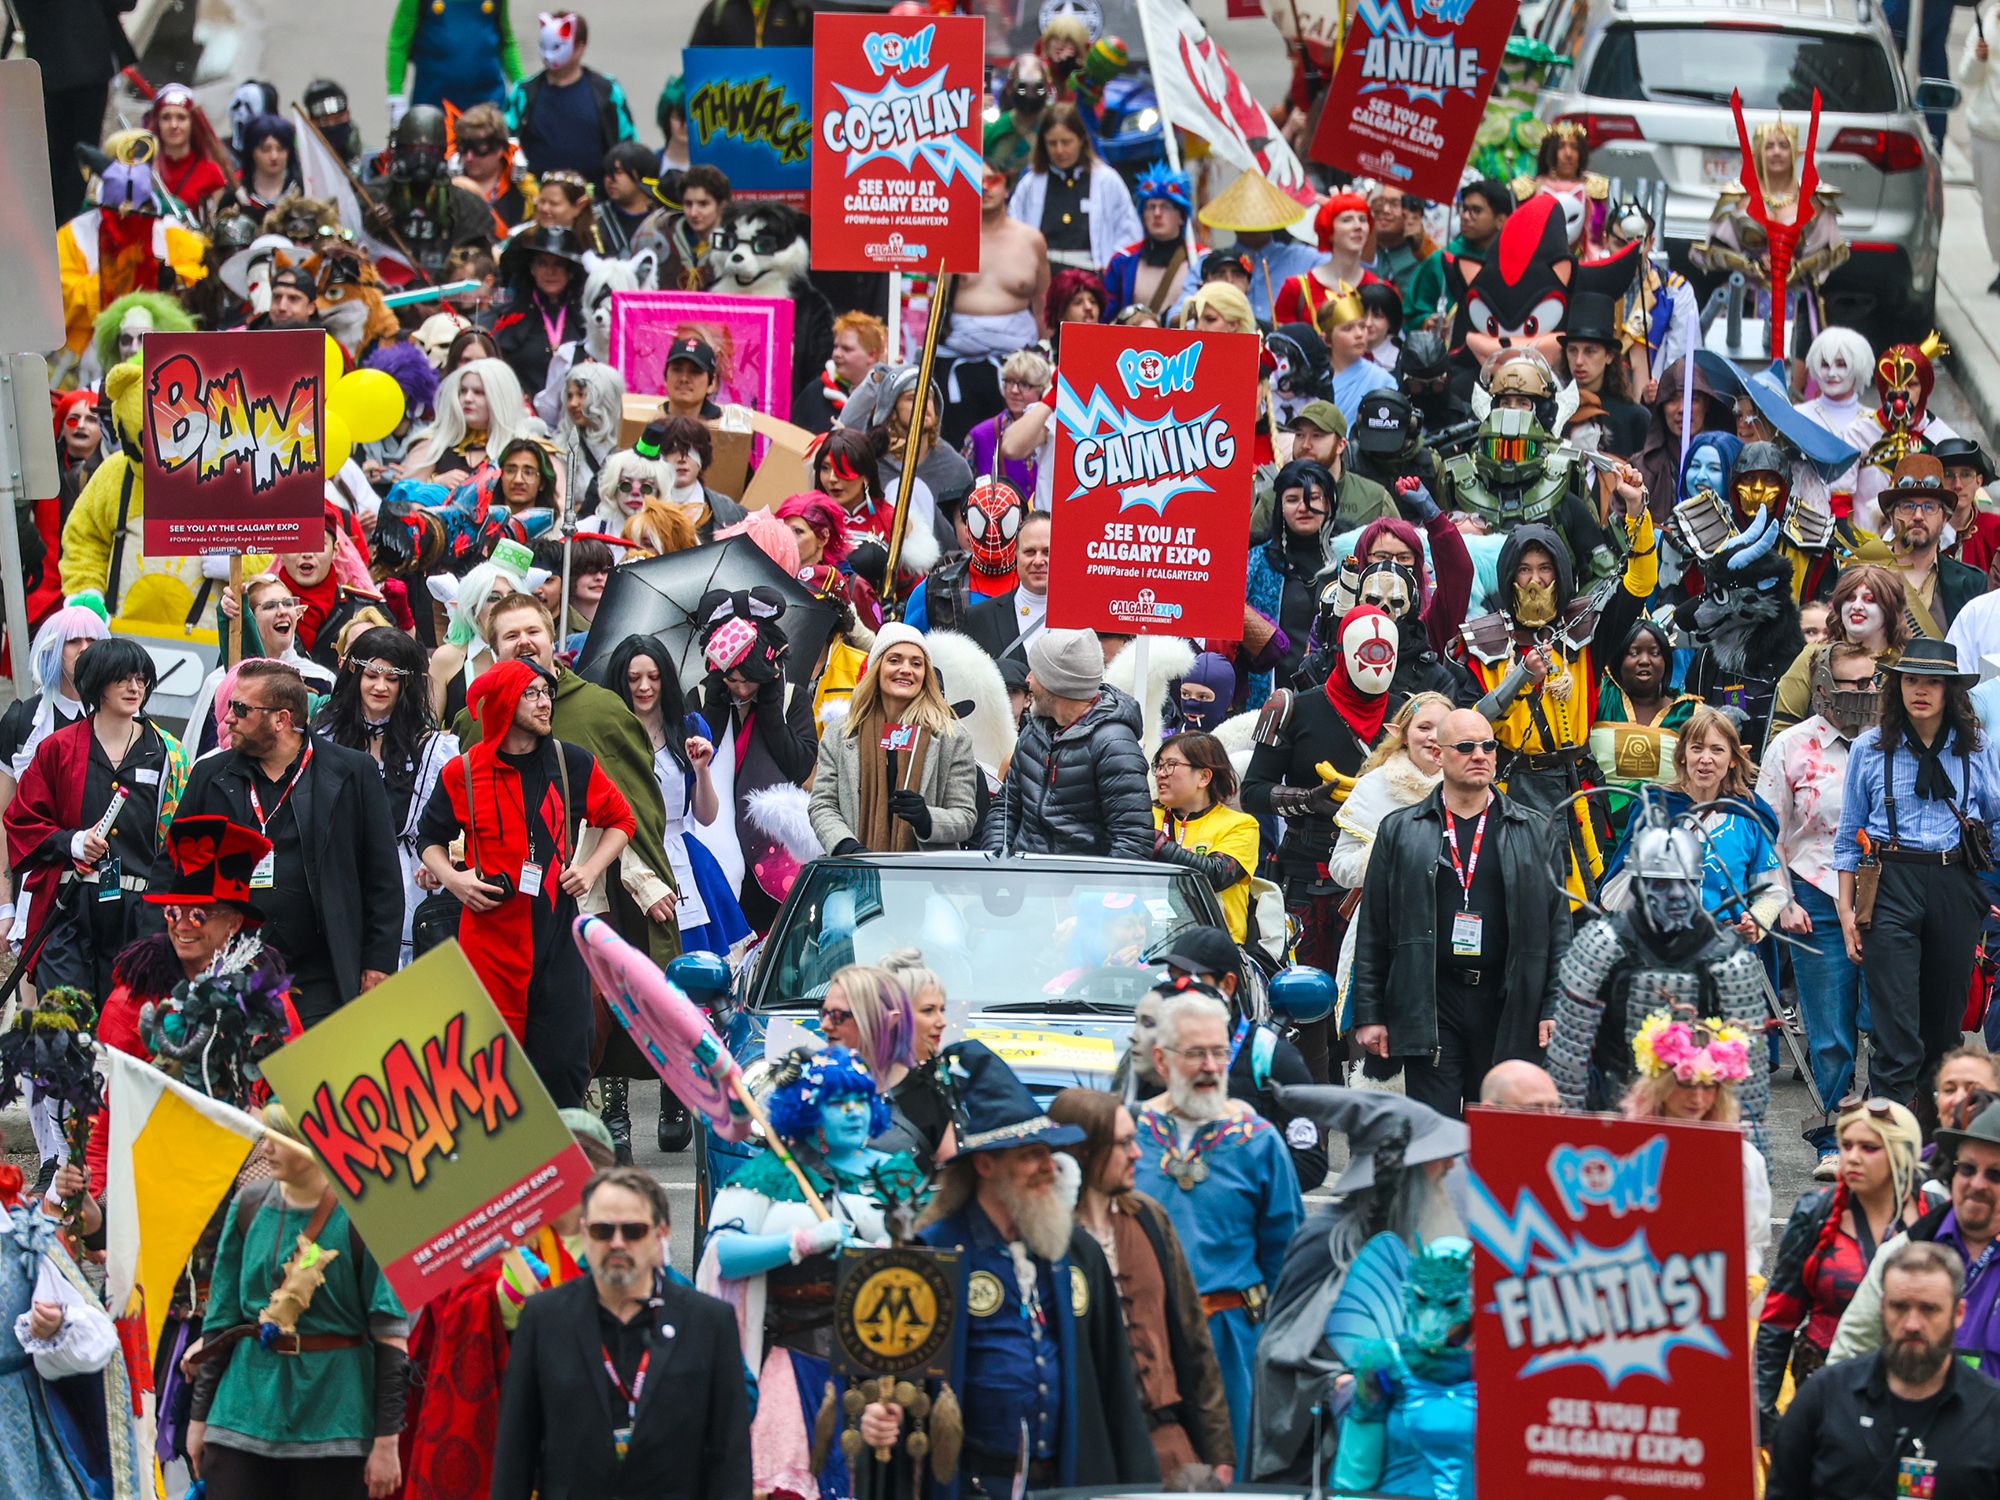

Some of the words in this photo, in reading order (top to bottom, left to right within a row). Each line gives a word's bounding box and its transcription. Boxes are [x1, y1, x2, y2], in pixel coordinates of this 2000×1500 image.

[863, 23, 936, 76] POW!
[1361, 37, 1478, 88] ANIME
[690, 76, 812, 164] THWACK
[822, 87, 970, 153] COSPLAY
[1352, 106, 1409, 137] CALGARY
[1410, 127, 1444, 149] EXPO
[1368, 97, 1392, 117] SEE
[1394, 104, 1420, 126] YOU
[1420, 116, 1438, 132] AT
[844, 195, 908, 212] CALGARY
[911, 197, 950, 213] EXPO
[858, 179, 883, 195] SEE
[886, 180, 915, 196] YOU
[918, 181, 936, 196] AT
[844, 214, 890, 225] #POWParade
[895, 216, 948, 226] #CALGARYEXPO
[1115, 340, 1203, 399] POW!
[147, 353, 320, 494] BAM
[1368, 417, 1399, 427] BEAR
[1072, 418, 1236, 489] GAMING
[169, 525, 184, 533] SEE
[187, 525, 205, 533] YOU
[219, 524, 235, 532] THE
[277, 523, 299, 531] EXPO
[1104, 523, 1133, 541] SEE
[1137, 525, 1172, 543] YOU
[1174, 527, 1196, 545] AT
[1087, 541, 1163, 562] CALGARY
[1166, 546, 1210, 566] EXPO
[1087, 564, 1140, 578] #POWParade
[1146, 568, 1209, 582] #CALGARYEXPO
[1109, 600, 1183, 619] CALGARYEXPO
[1468, 852, 1478, 873] CREW
[299, 1011, 522, 1201] KRAKK
[1547, 1133, 1669, 1220] POW!
[413, 1247, 433, 1265] SEE
[432, 1233, 454, 1252] YOU
[455, 1224, 467, 1239] AT
[467, 1211, 488, 1229] THE
[486, 1183, 530, 1217] CALGARY
[529, 1165, 558, 1189] EXPO
[1494, 1251, 1727, 1349] FANTASY
[1547, 1397, 1593, 1427] SEE
[1594, 1401, 1647, 1432] YOU
[1648, 1405, 1680, 1435] AT
[1524, 1424, 1634, 1460] CALGARY
[1636, 1433, 1705, 1466] EXPO
